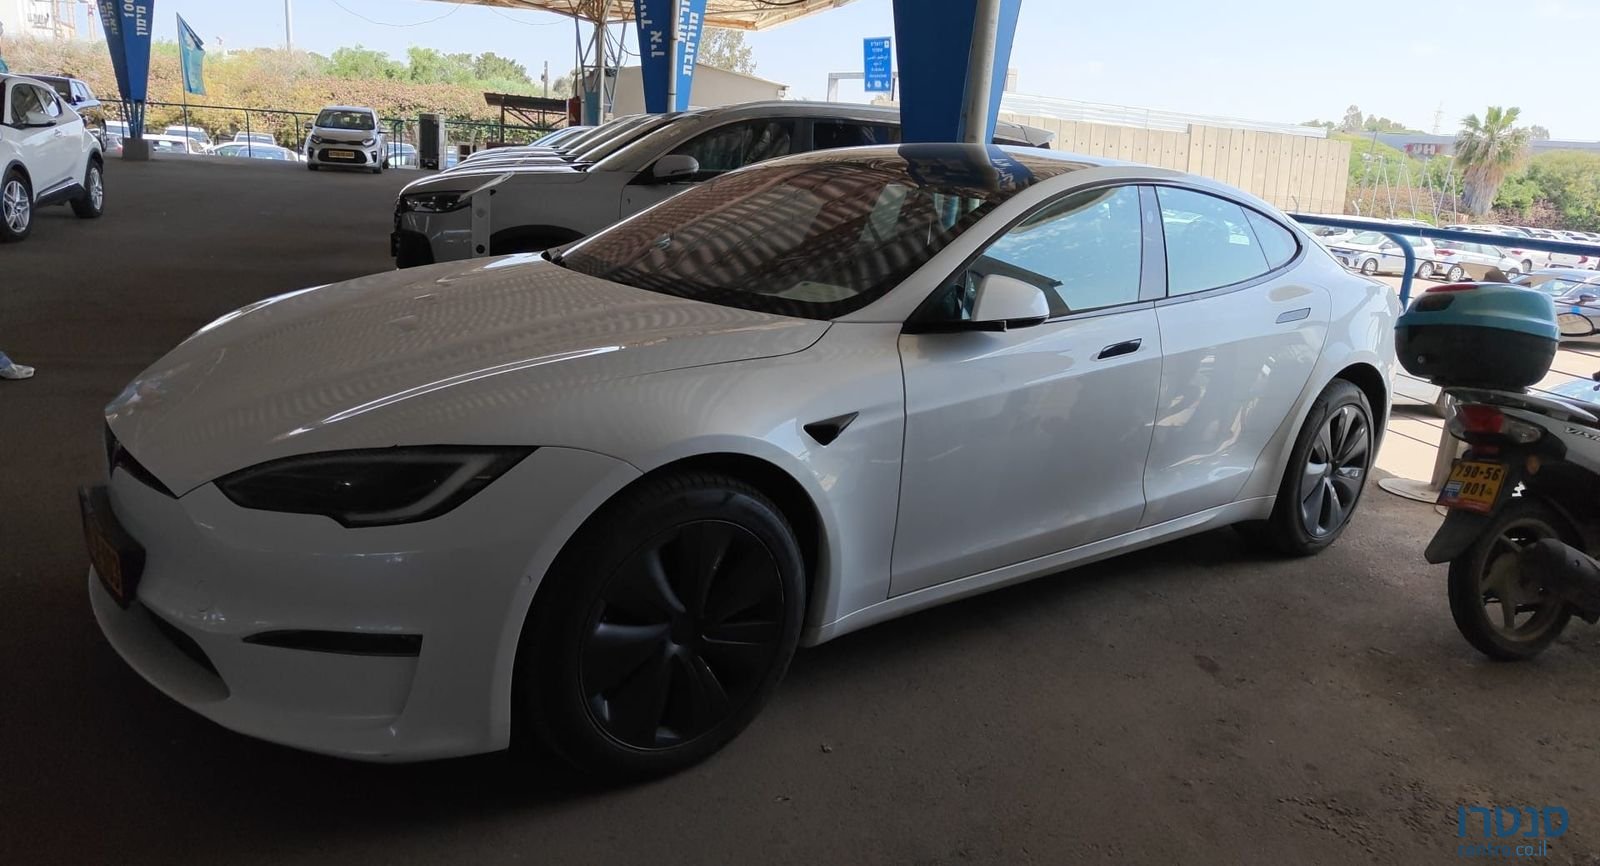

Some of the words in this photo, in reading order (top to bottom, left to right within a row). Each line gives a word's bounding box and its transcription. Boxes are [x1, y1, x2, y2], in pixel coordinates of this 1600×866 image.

[136, 5, 149, 36] מימון
[650, 30, 665, 58] אין
[682, 11, 699, 76] מורחבת
